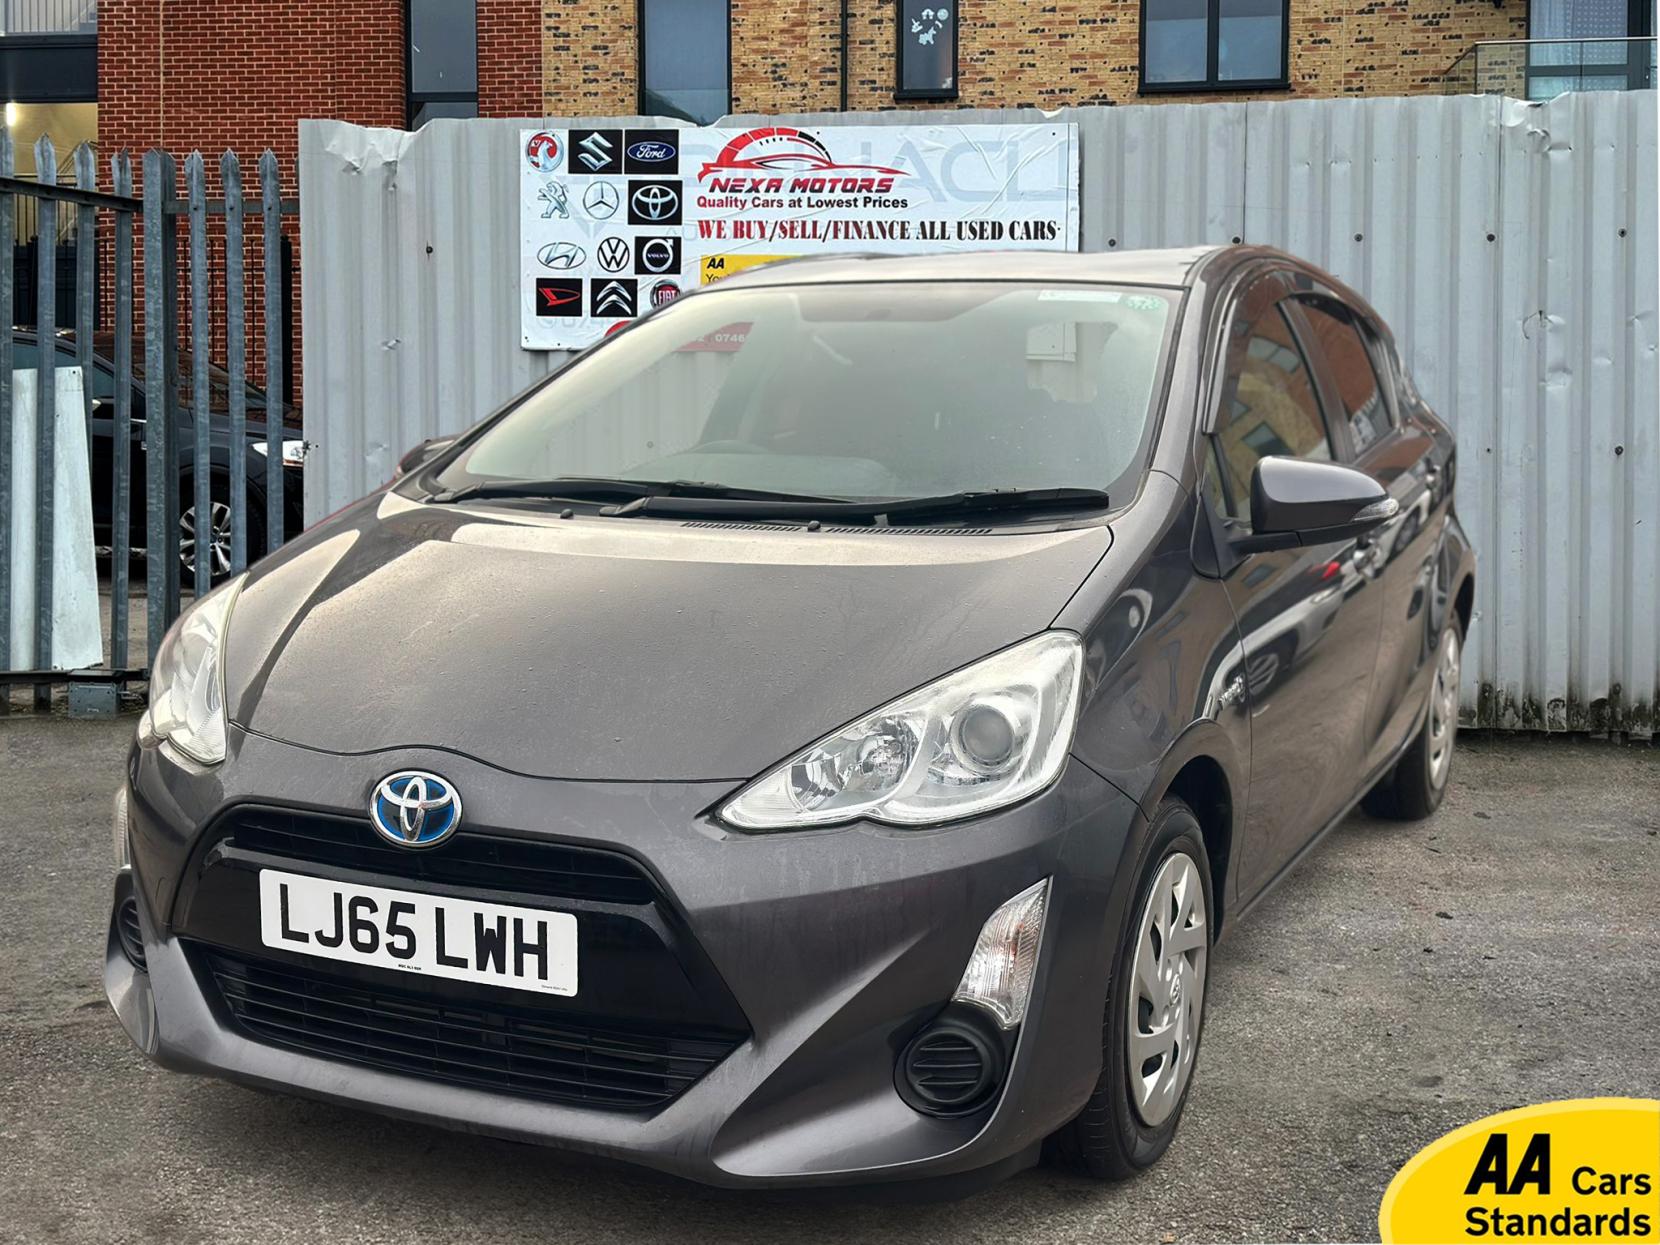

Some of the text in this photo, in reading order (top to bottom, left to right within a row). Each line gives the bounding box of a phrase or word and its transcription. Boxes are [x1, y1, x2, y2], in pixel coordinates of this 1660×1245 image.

[637, 144, 667, 159] Ford
[708, 177, 895, 194] NEXA MOTORS
[697, 196, 909, 210] Quality Cars at Lowest Prices
[697, 220, 727, 240] WE
[916, 220, 951, 240] ALL
[956, 220, 1004, 241] USED
[1008, 220, 1057, 241] CARS
[706, 257, 725, 269] AA
[658, 290, 676, 305] FIAT
[280, 883, 548, 981] LJ65 LWH
